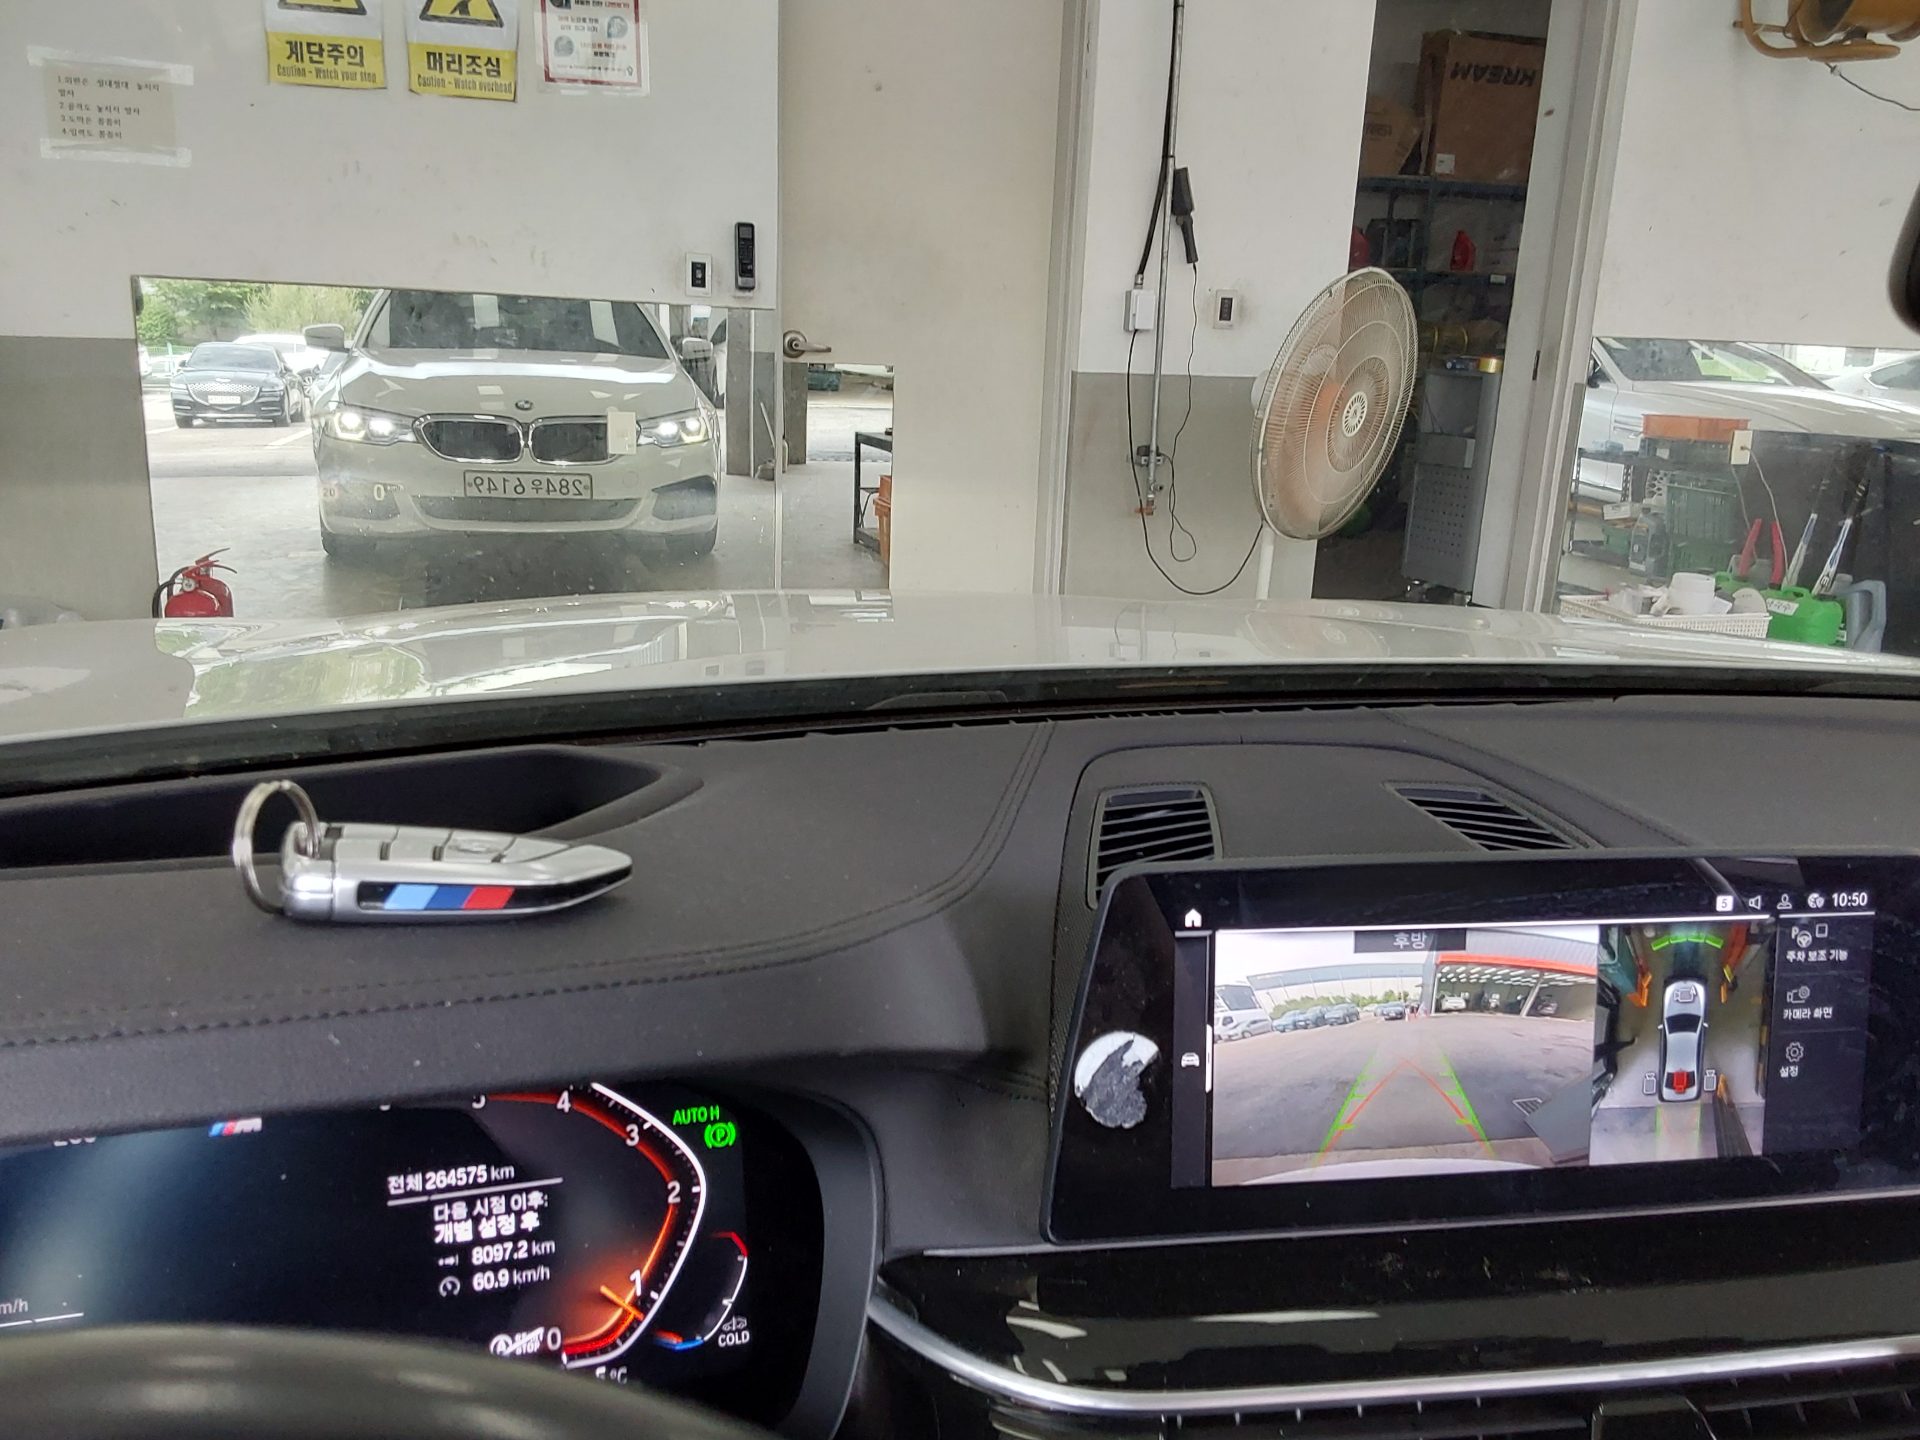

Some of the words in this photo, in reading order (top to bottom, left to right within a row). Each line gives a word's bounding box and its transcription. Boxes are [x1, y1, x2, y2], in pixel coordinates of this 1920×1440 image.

[285, 40, 365, 68] 계단주의
[426, 51, 502, 78] 머리조심
[277, 63, 307, 78] Caution
[314, 66, 339, 81] Watch
[341, 69, 358, 81] your
[360, 70, 377, 84] step
[417, 74, 446, 89] Caution
[454, 76, 477, 91] Watch
[479, 80, 513, 95] overhead
[1451, 62, 1538, 86] KREAM
[1832, 892, 1868, 907] 10:50
[1393, 931, 1427, 950] 후방
[1783, 1007, 1811, 1021] 카메라
[1813, 1006, 1833, 1019] 화면
[1779, 1065, 1799, 1078] 설정
[556, 1090, 571, 1113] 4
[672, 1105, 708, 1126] AUTO
[710, 1104, 720, 1121] H
[625, 1124, 640, 1147] 3
[387, 1172, 423, 1195] 전체
[425, 1164, 488, 1191] 264575
[490, 1165, 515, 1181] km
[667, 1180, 681, 1204] 2
[433, 1200, 468, 1222] 다음
[472, 1196, 507, 1217] 시점
[433, 1218, 474, 1244] 개별
[478, 1212, 516, 1239] 설정
[520, 1210, 541, 1232] 후
[471, 1239, 529, 1266] 8097.2
[531, 1239, 556, 1256] km
[472, 1267, 510, 1292] 60.9
[512, 1264, 551, 1285] km/h
[629, 1269, 642, 1297] 1
[546, 1327, 562, 1351] 0
[717, 1331, 750, 1347] COLD
